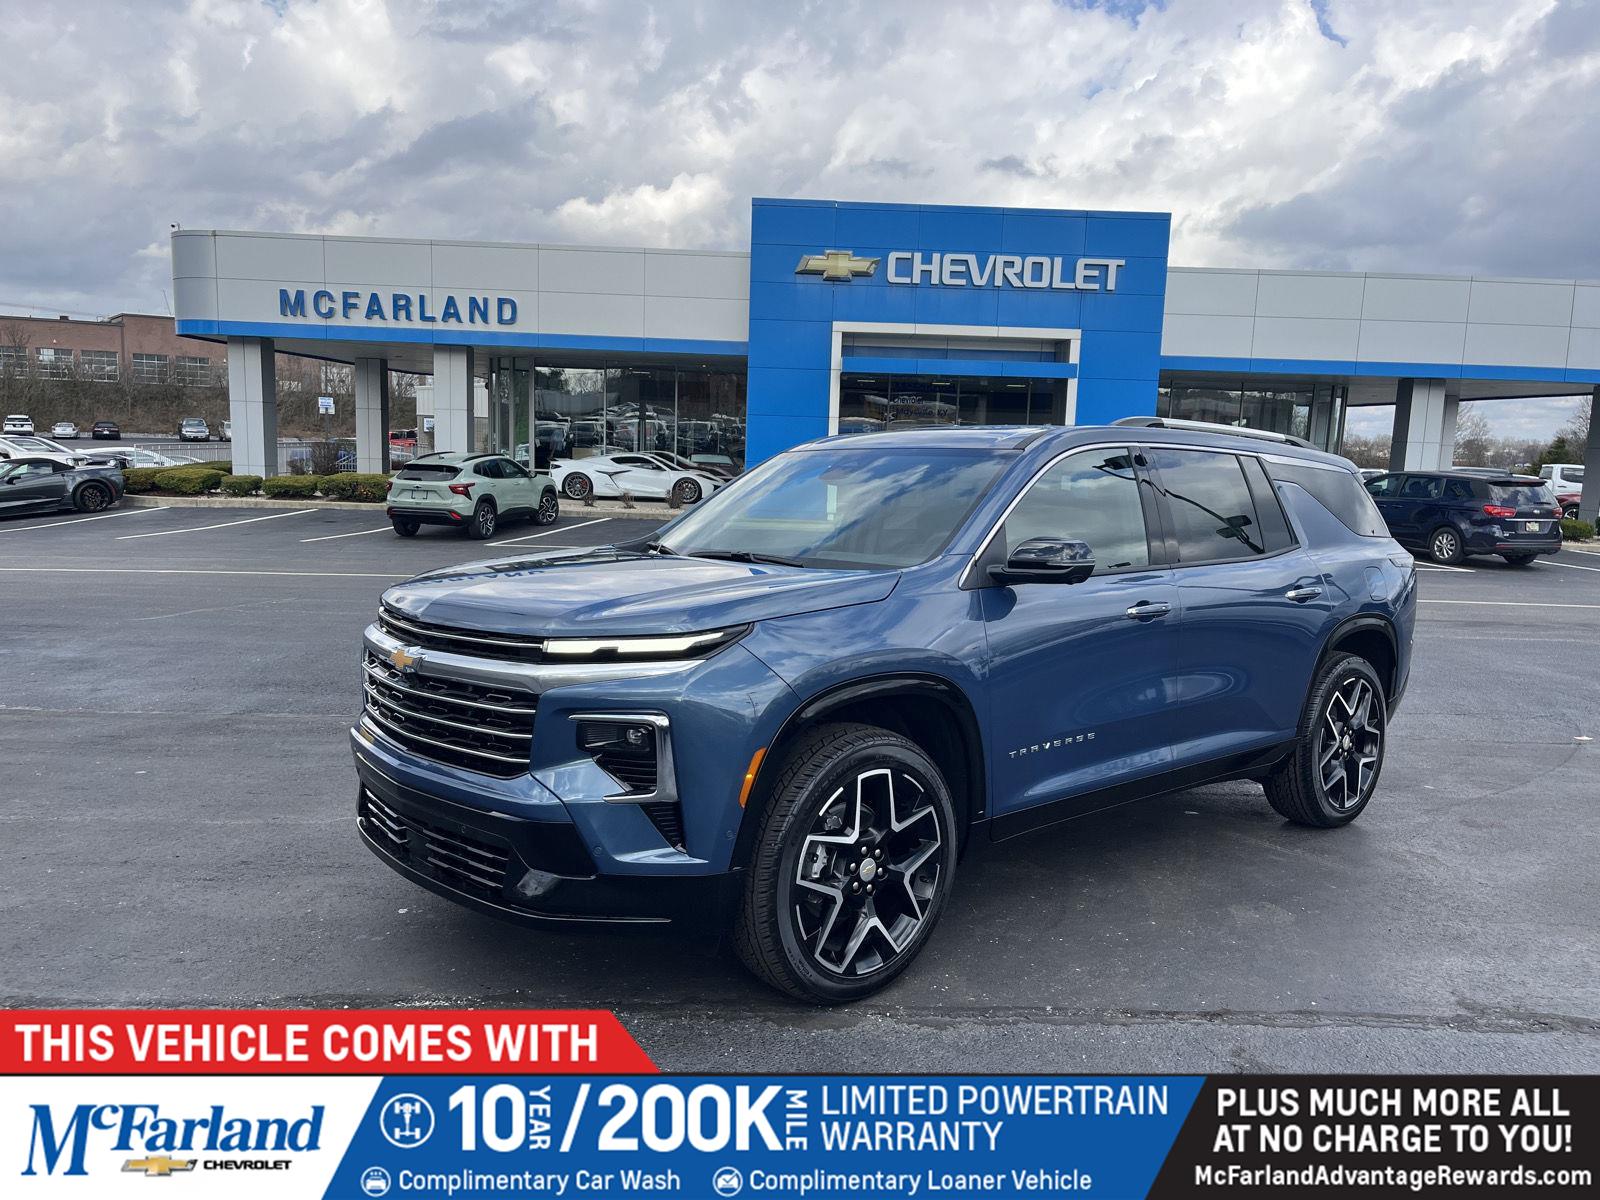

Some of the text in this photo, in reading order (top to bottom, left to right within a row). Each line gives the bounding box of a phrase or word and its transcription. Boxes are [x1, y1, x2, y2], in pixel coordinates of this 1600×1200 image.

[887, 251, 1125, 291] CHEVROLET
[279, 288, 518, 325] MCFARLAND
[1008, 732, 1096, 759] TRAVERSE
